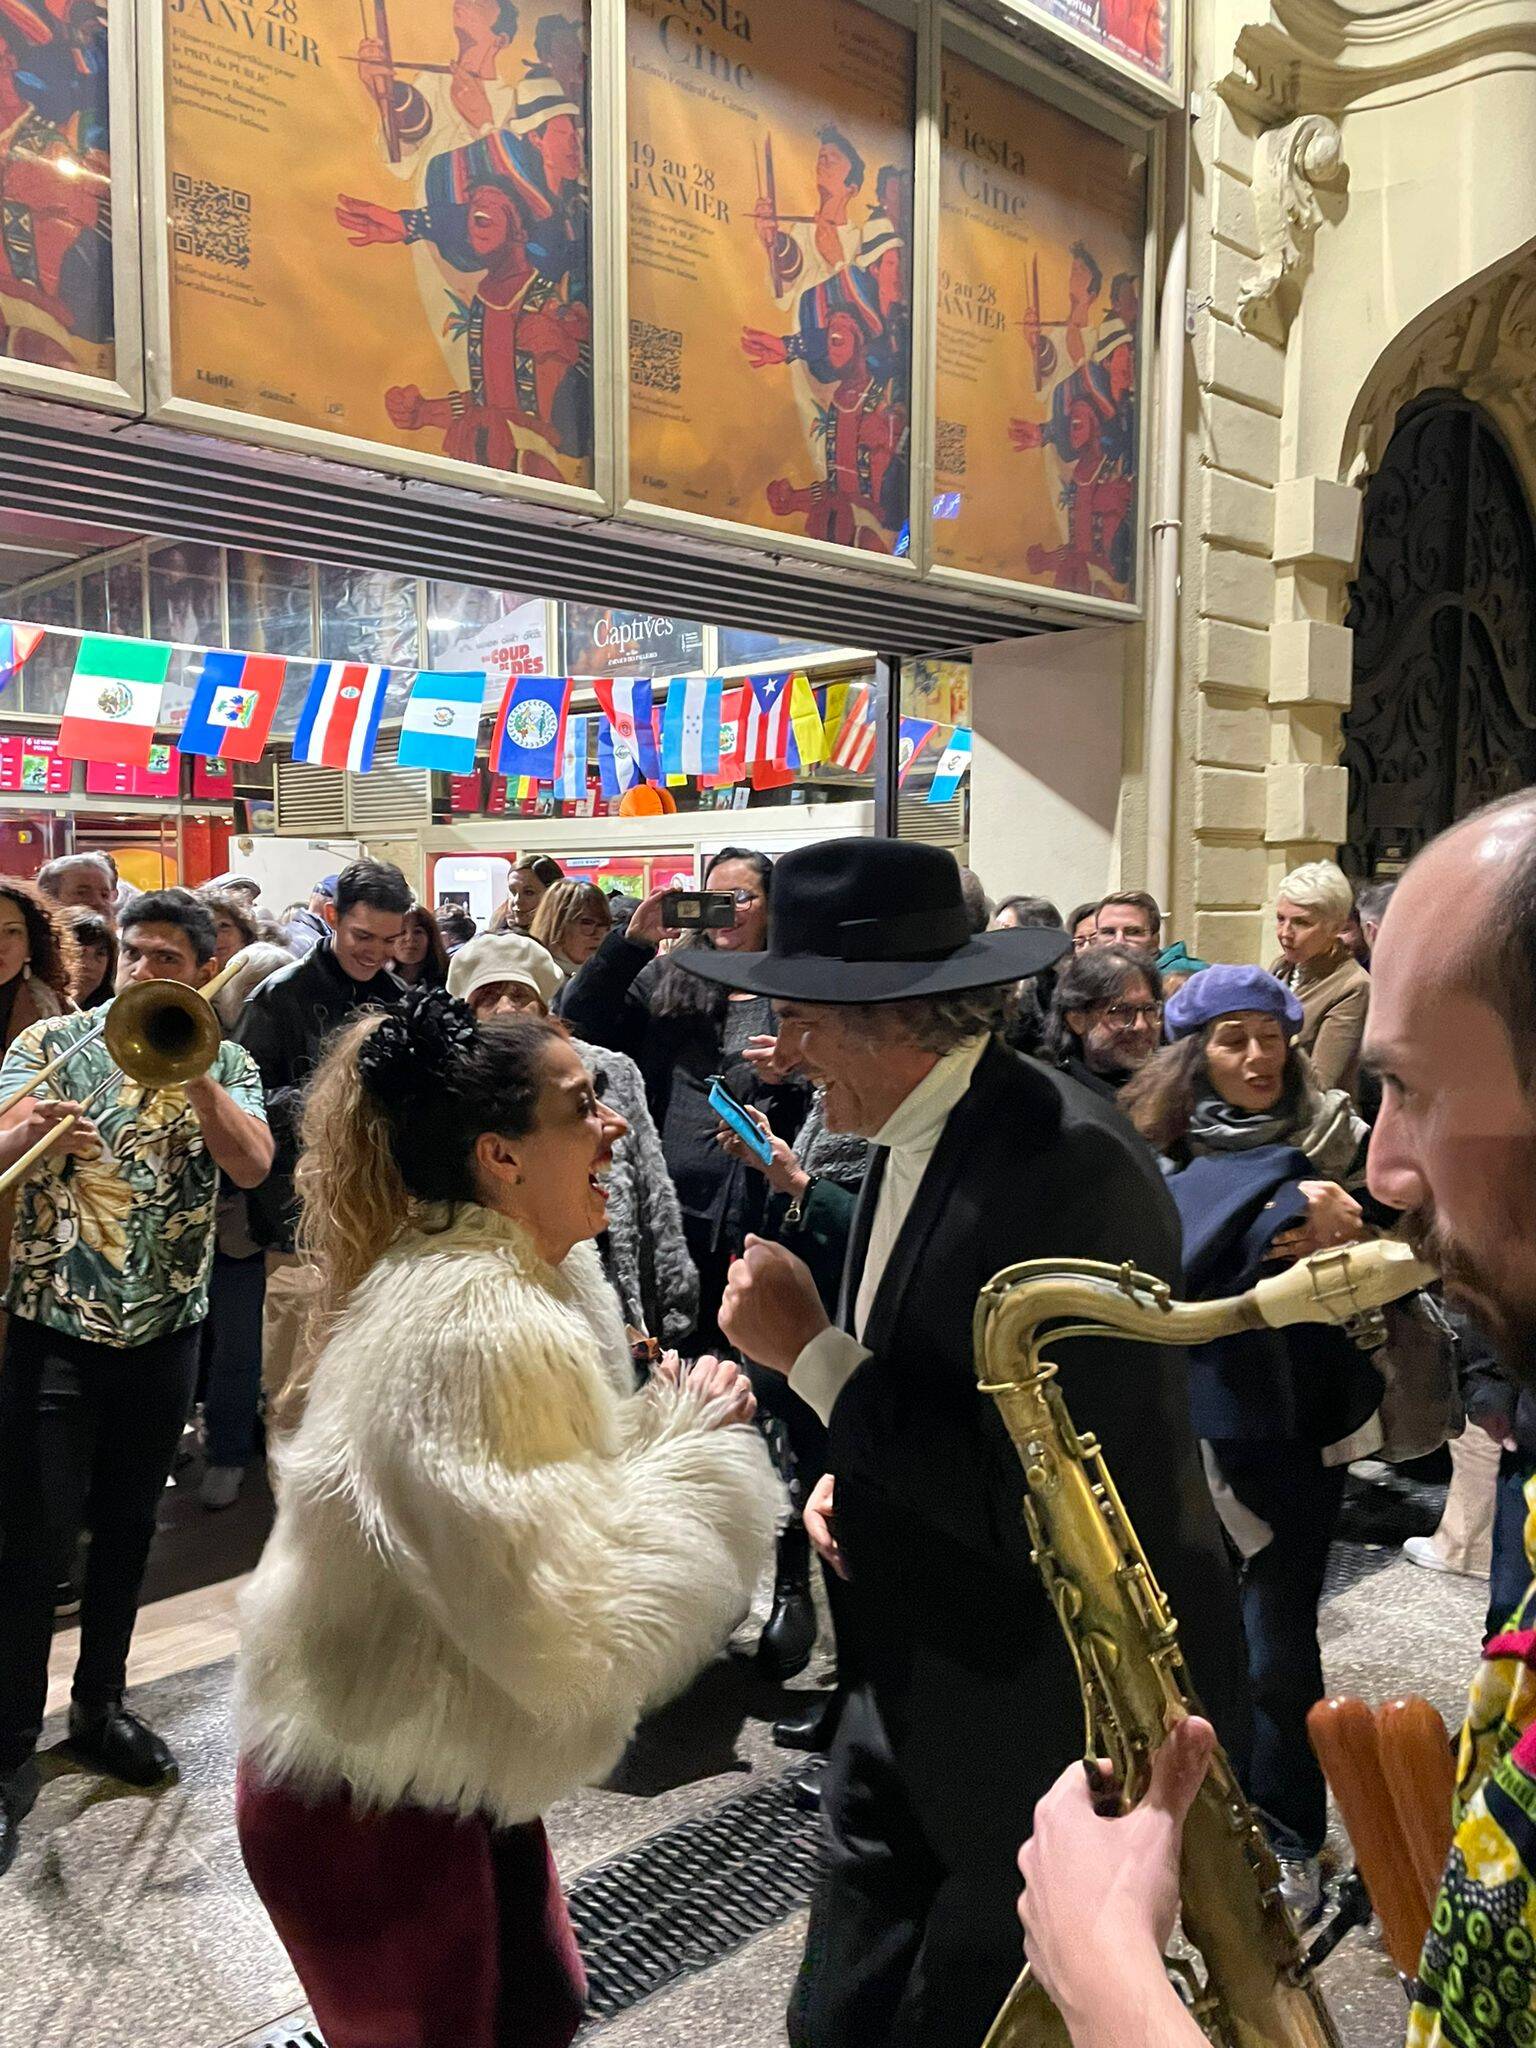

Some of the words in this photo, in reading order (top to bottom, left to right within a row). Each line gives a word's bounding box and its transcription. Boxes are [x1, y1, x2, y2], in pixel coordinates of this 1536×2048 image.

[265, 0, 298, 24] 28
[659, 14, 755, 94] Cine
[632, 140, 656, 168] 19
[662, 159, 688, 180] au
[692, 163, 716, 193] 28
[629, 168, 730, 224] JANVIER
[954, 282, 973, 299] au
[978, 283, 997, 305] 28
[593, 615, 674, 653] Captives
[491, 644, 530, 665] COUP
[499, 662, 510, 671] DE
[511, 655, 544, 674] DÉS
